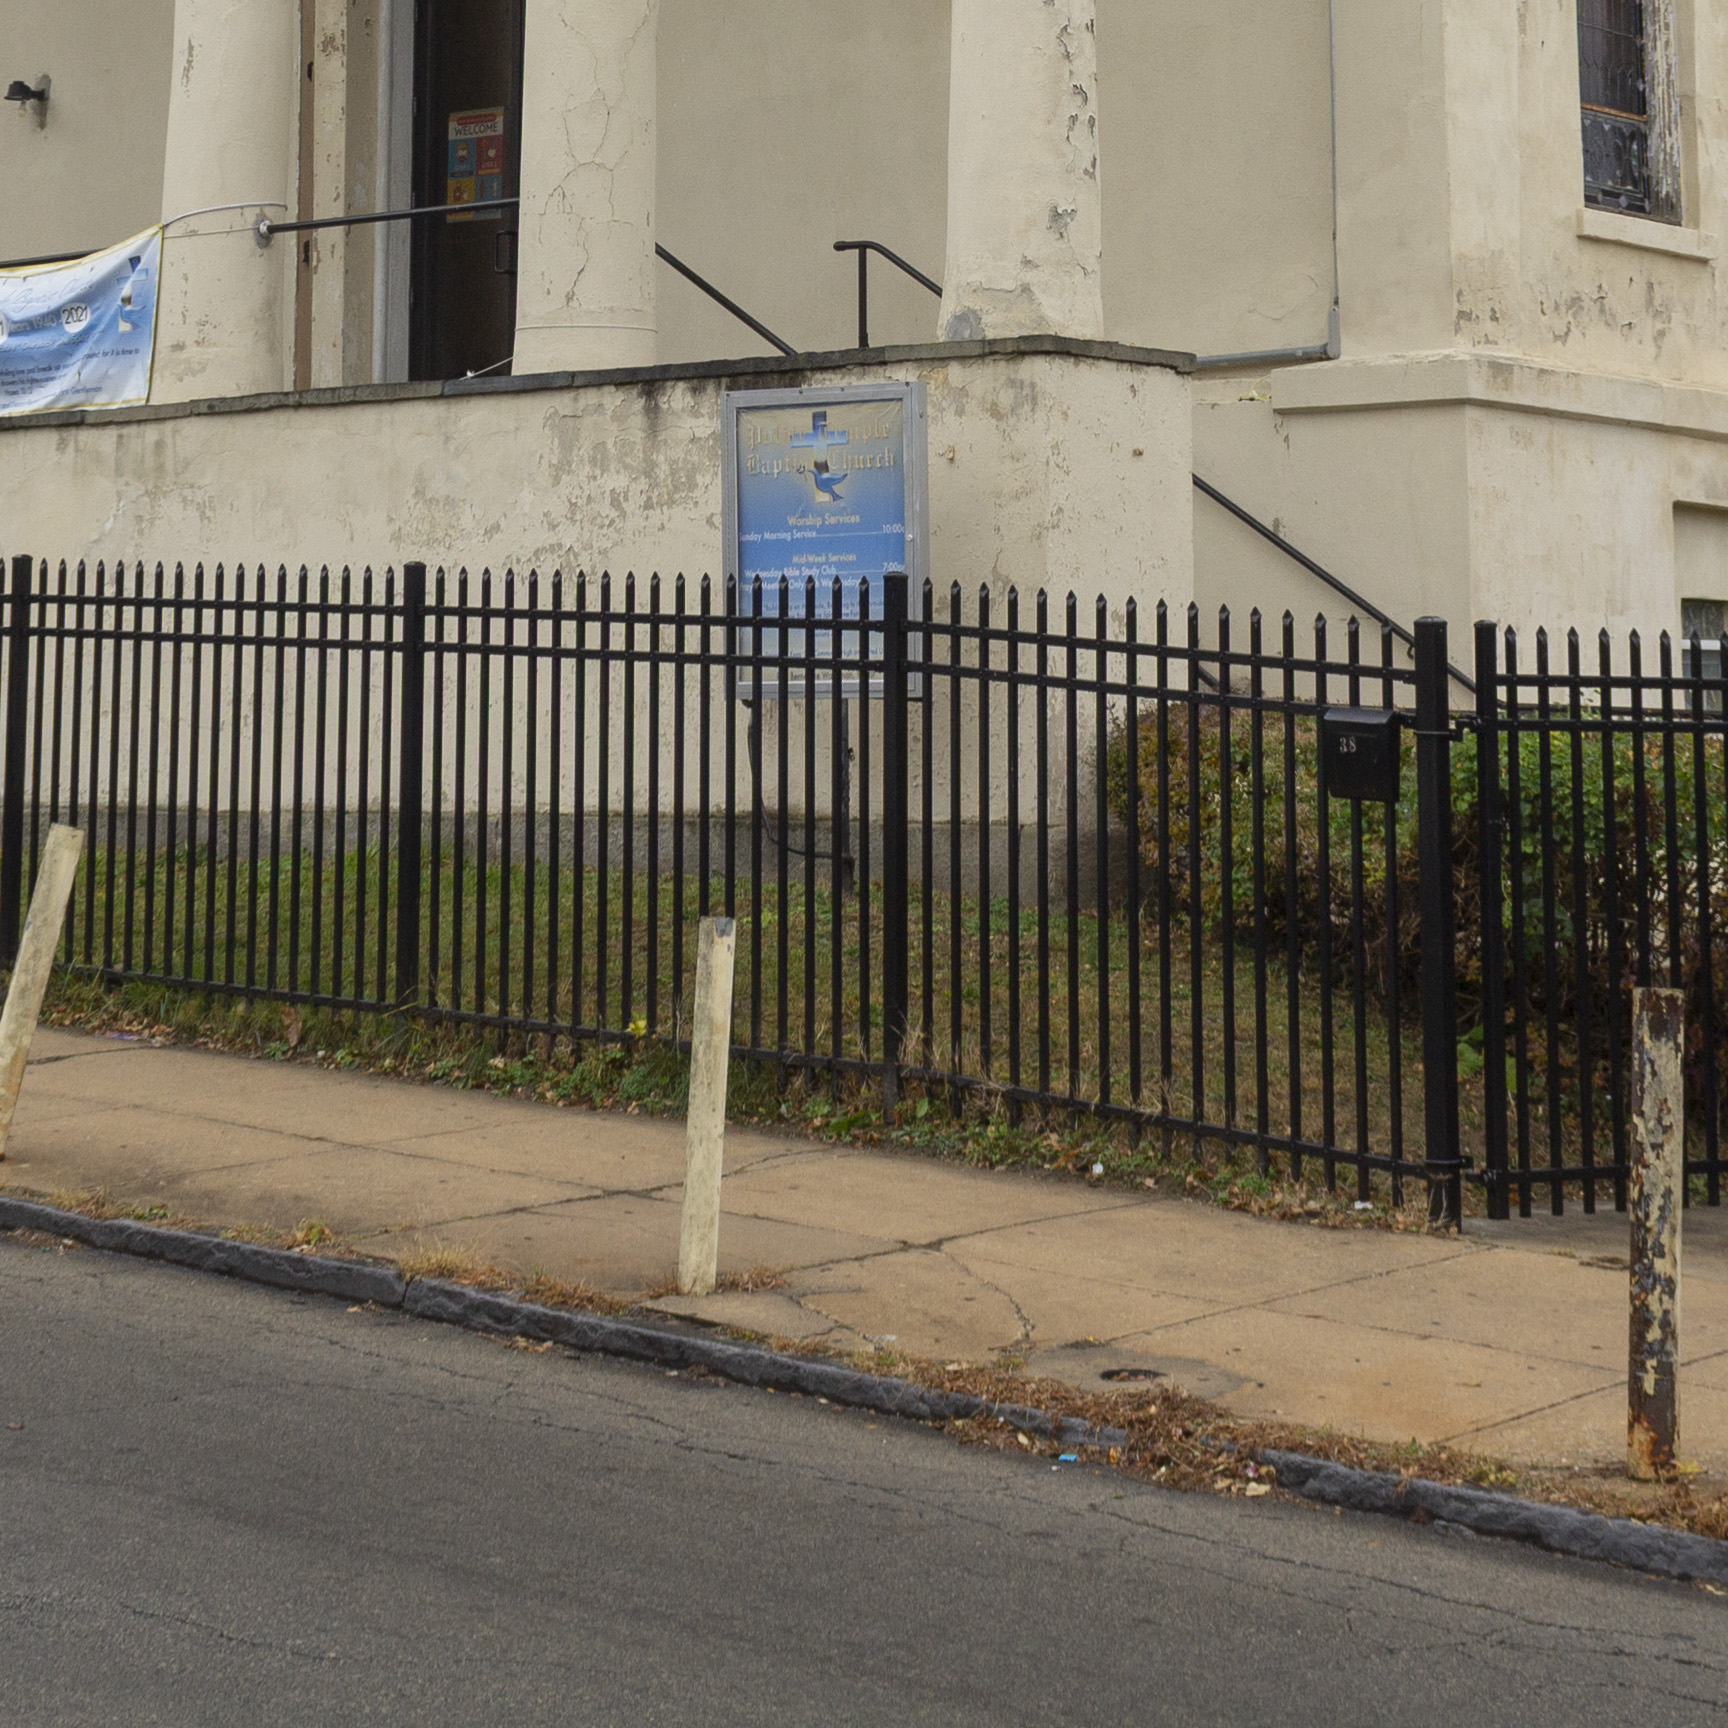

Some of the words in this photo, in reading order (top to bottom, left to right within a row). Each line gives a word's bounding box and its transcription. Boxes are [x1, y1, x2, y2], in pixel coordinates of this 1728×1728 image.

[454, 122, 498, 137] WELCOME
[62, 304, 89, 325] 2021
[827, 446, 895, 471] Church
[787, 514, 822, 528] Worship
[824, 512, 860, 525] Services
[763, 529, 792, 542] Morning
[793, 528, 817, 538] Service
[828, 552, 857, 562] Services
[784, 566, 800, 576] Bible
[802, 565, 819, 577] Study
[821, 564, 837, 575] Club
[788, 580, 804, 591] Only
[1339, 736, 1357, 753] 38
